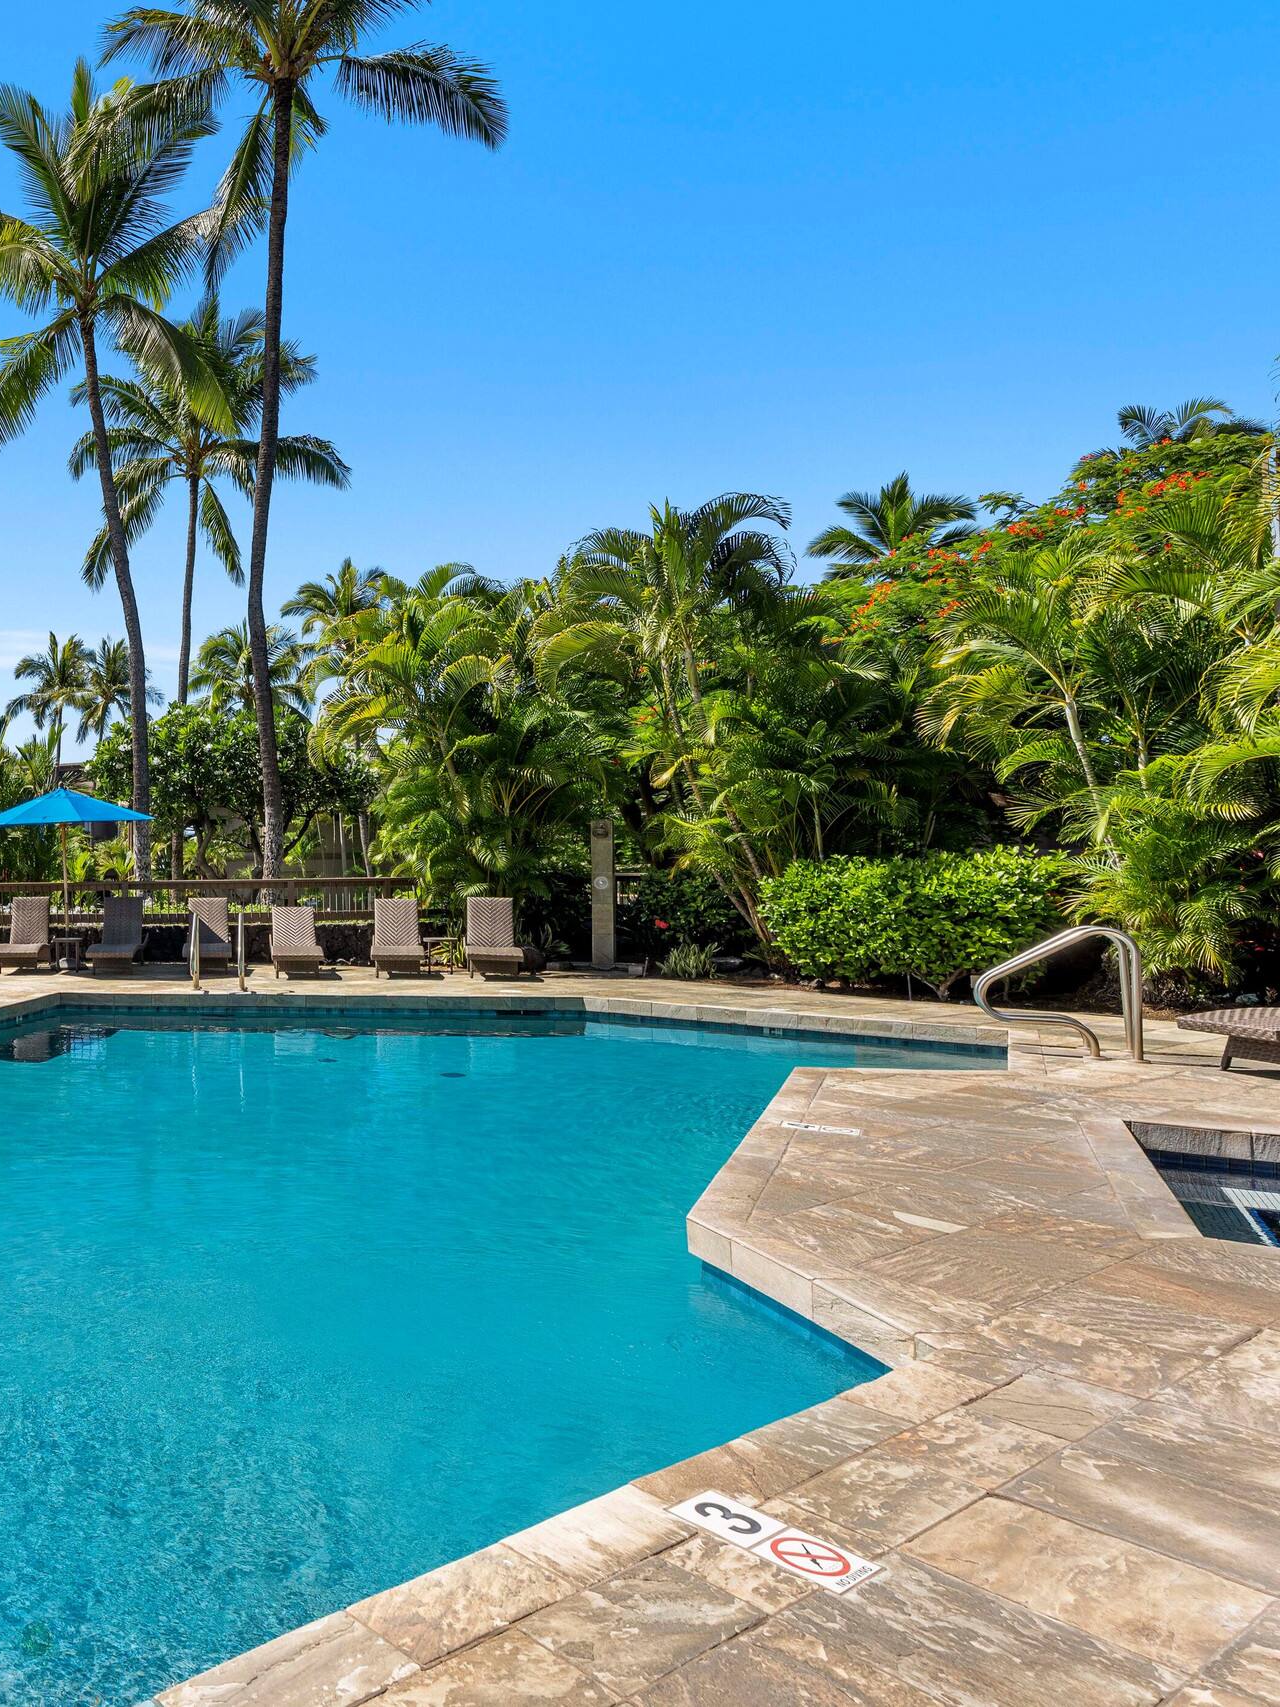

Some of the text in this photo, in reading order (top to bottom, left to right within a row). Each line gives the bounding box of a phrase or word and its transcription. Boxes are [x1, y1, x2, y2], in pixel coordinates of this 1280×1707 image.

[694, 1501, 762, 1535] 3
[835, 1565, 873, 1588] NO DIVING
